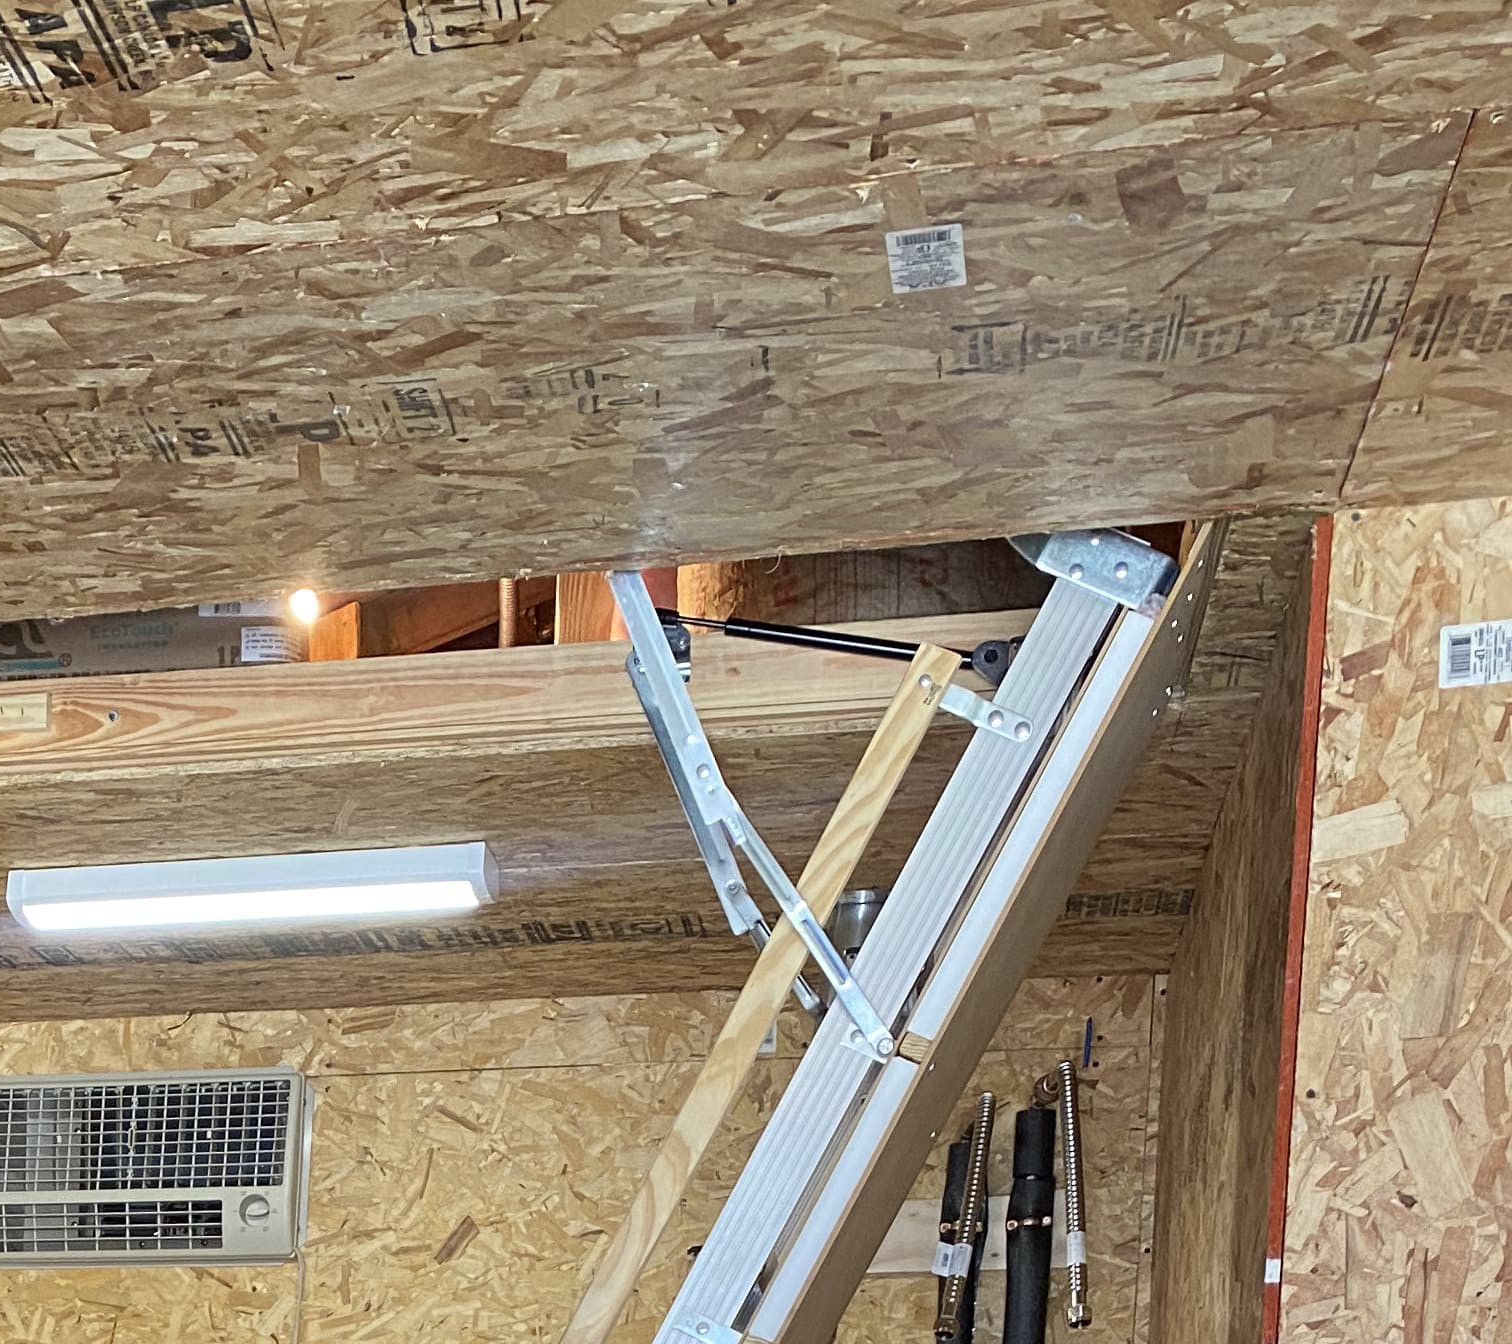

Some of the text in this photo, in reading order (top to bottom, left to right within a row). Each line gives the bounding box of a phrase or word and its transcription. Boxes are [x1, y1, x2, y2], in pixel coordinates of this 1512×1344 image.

[14, 5, 104, 90] APA
[390, 386, 438, 420] SHIFT
[90, 623, 173, 640] EcoTouch
